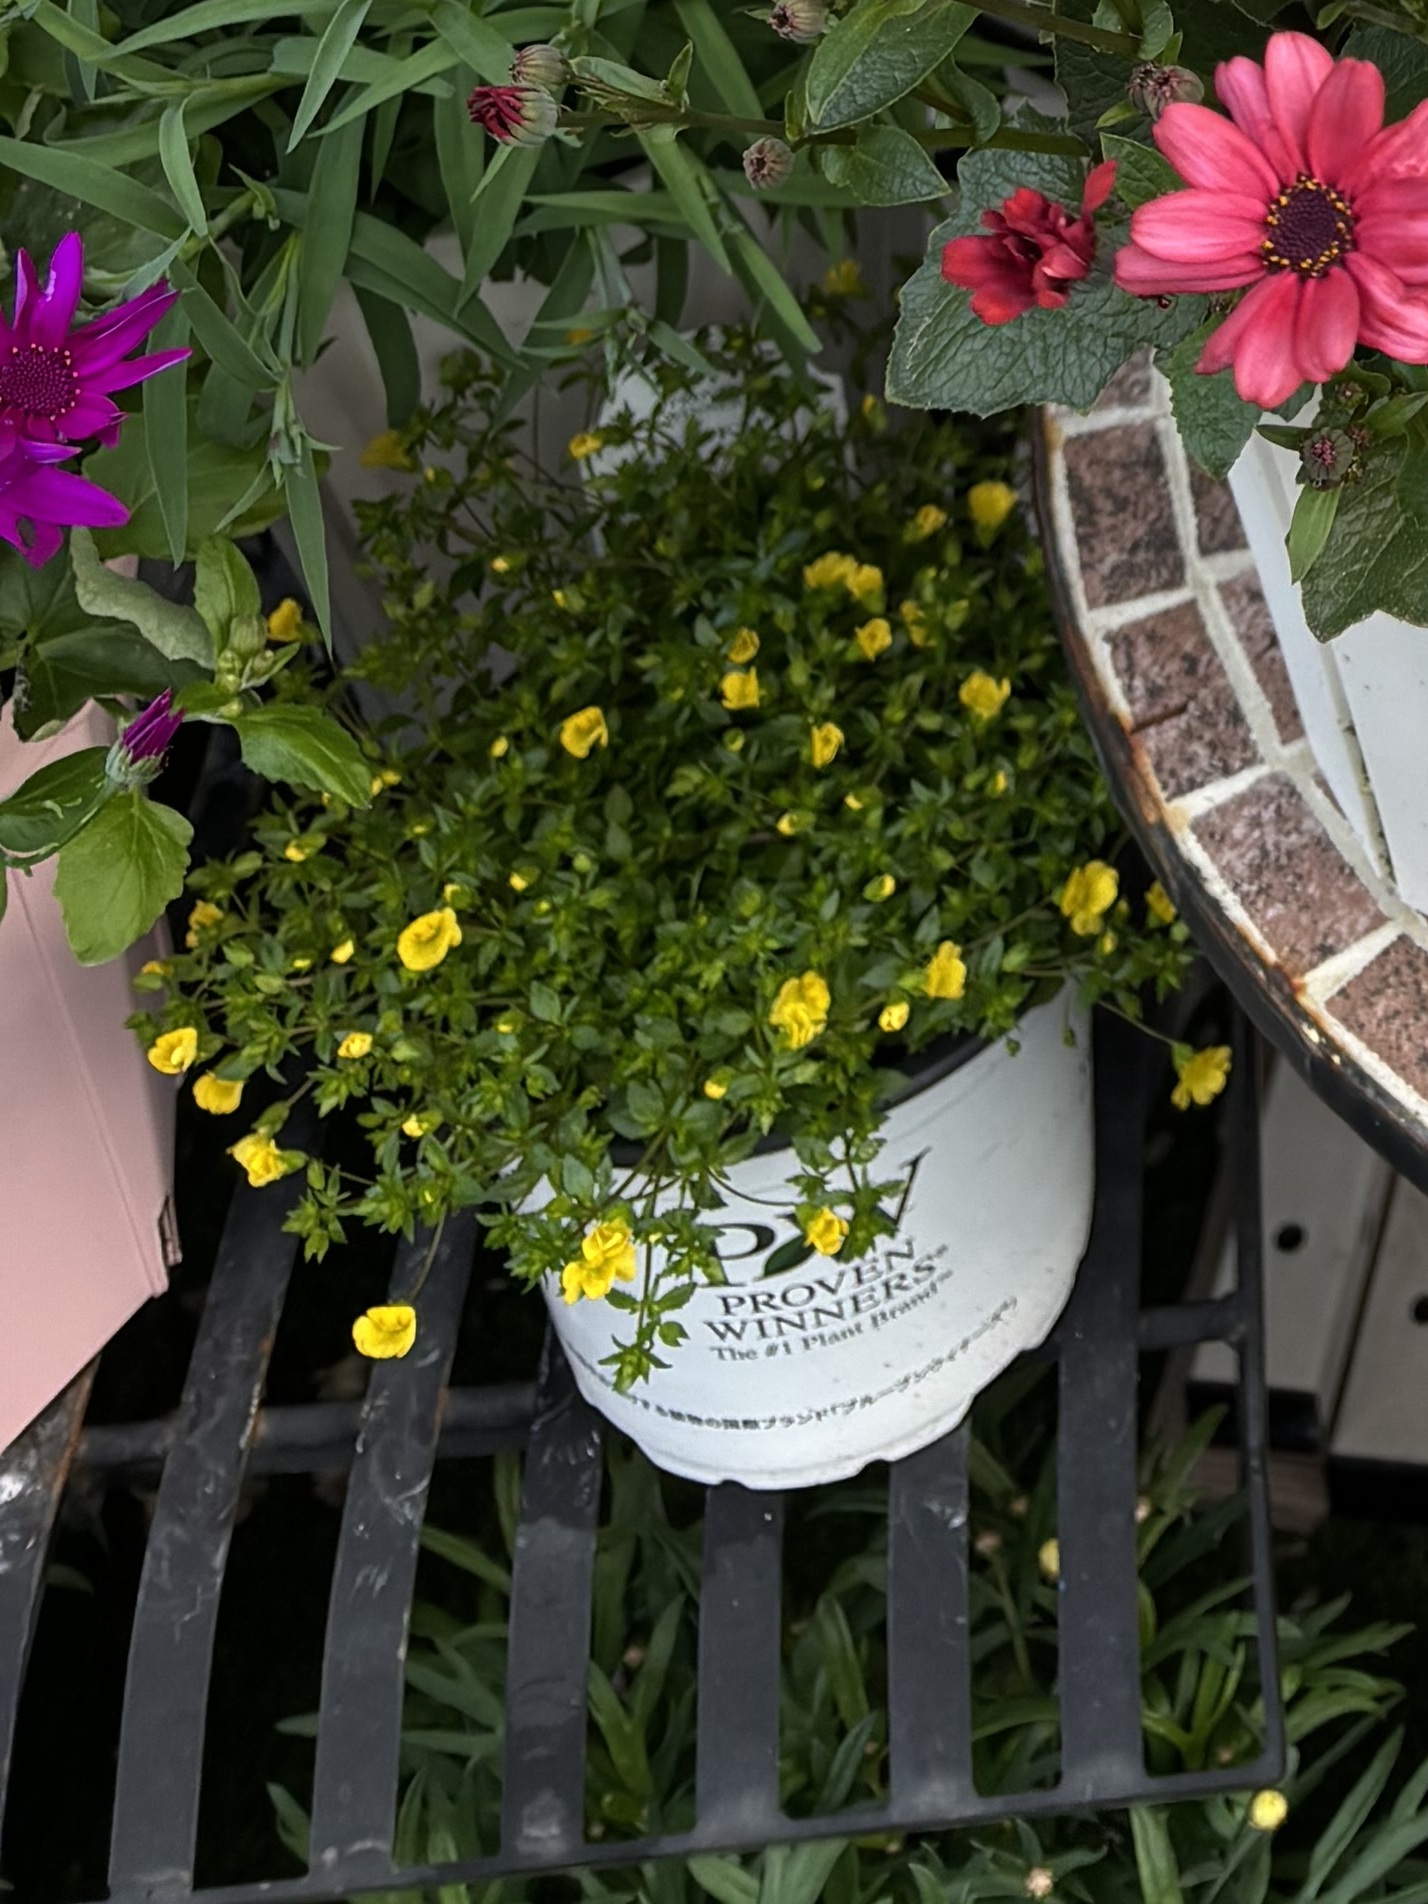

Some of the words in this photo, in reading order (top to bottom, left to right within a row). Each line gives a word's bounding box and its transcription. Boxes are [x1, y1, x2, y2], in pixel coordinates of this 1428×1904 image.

[717, 1238, 915, 1316] PROVEN
[709, 1343, 758, 1361] The
[765, 1341, 792, 1358] #1
[801, 1321, 864, 1352] Plant
